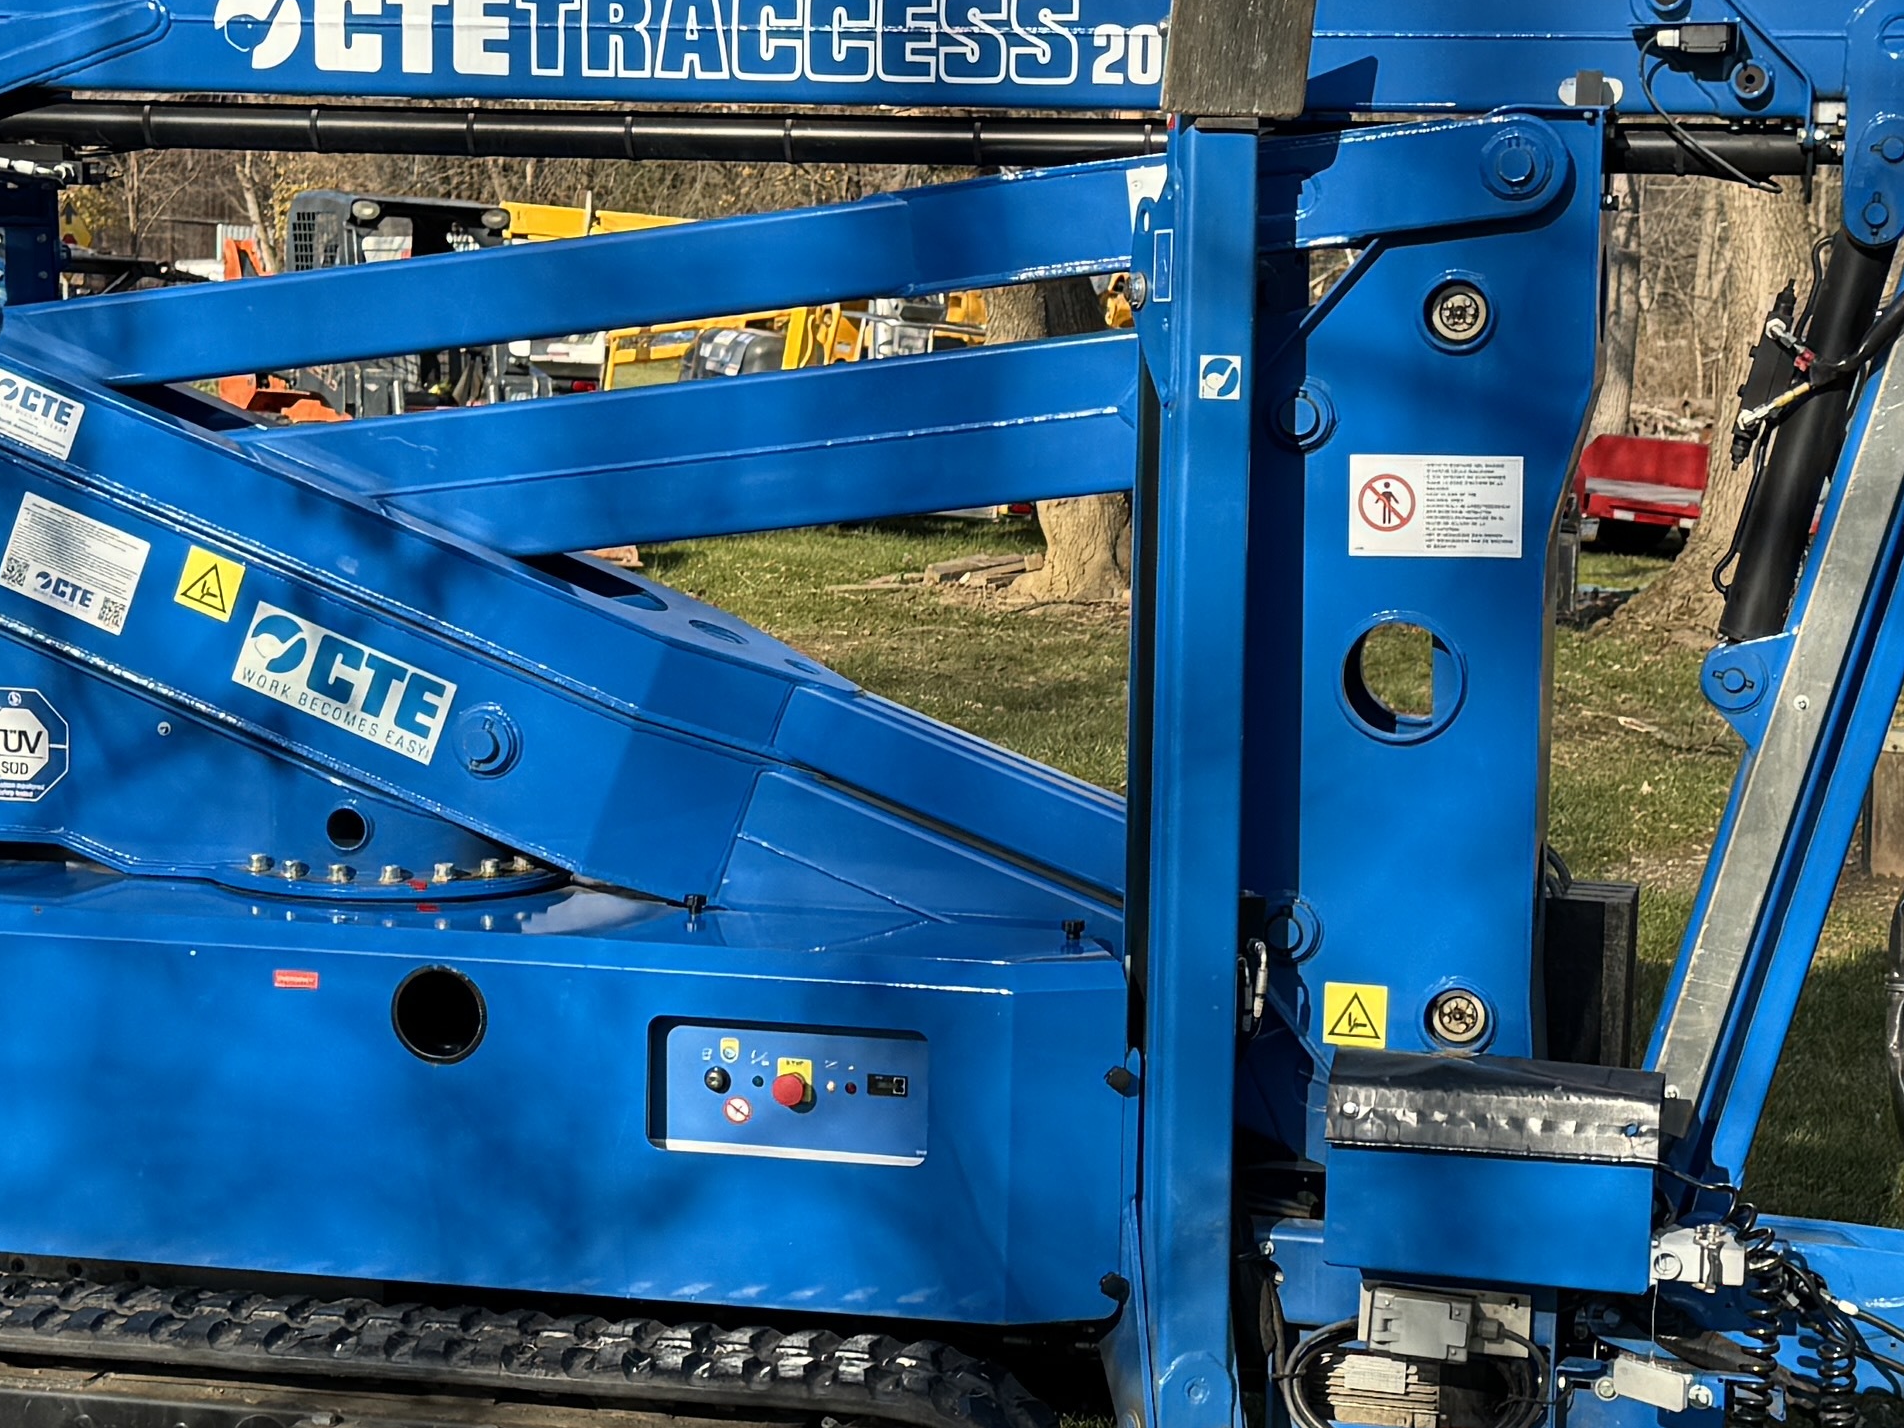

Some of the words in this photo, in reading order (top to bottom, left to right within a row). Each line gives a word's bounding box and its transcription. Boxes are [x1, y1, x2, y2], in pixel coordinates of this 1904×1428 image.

[1091, 23, 1164, 86] 20
[19, 385, 75, 427] CTE
[52, 577, 95, 608] CTE
[241, 666, 292, 699] WORK
[298, 691, 379, 738] BECOMES
[306, 634, 447, 740] CTE
